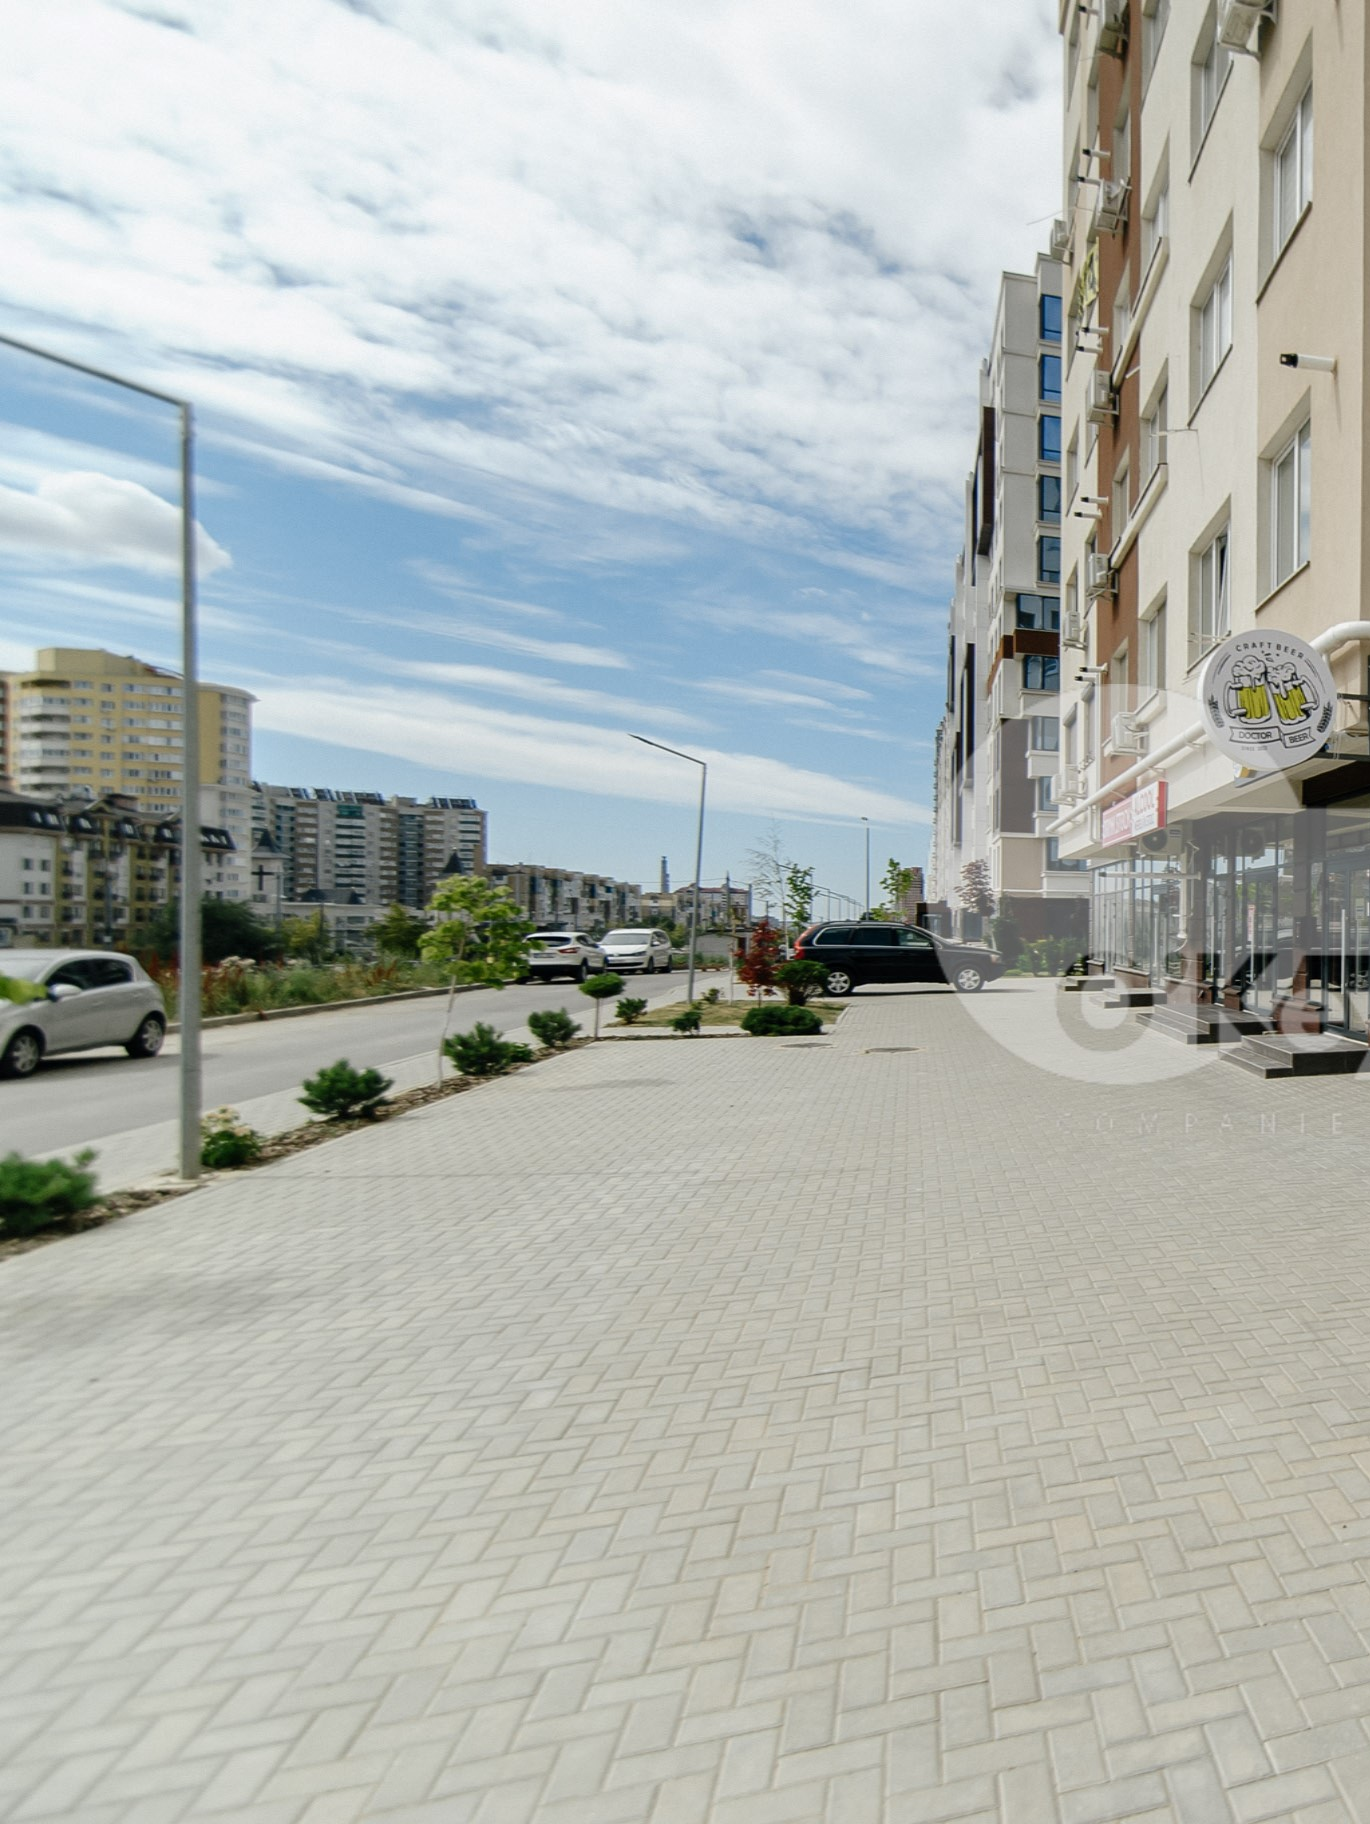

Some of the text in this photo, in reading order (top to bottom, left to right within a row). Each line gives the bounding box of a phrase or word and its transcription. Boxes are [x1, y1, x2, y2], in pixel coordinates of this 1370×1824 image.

[1235, 641, 1305, 659] CRAFT BEER
[1238, 731, 1309, 744] DOCTOR BEER
